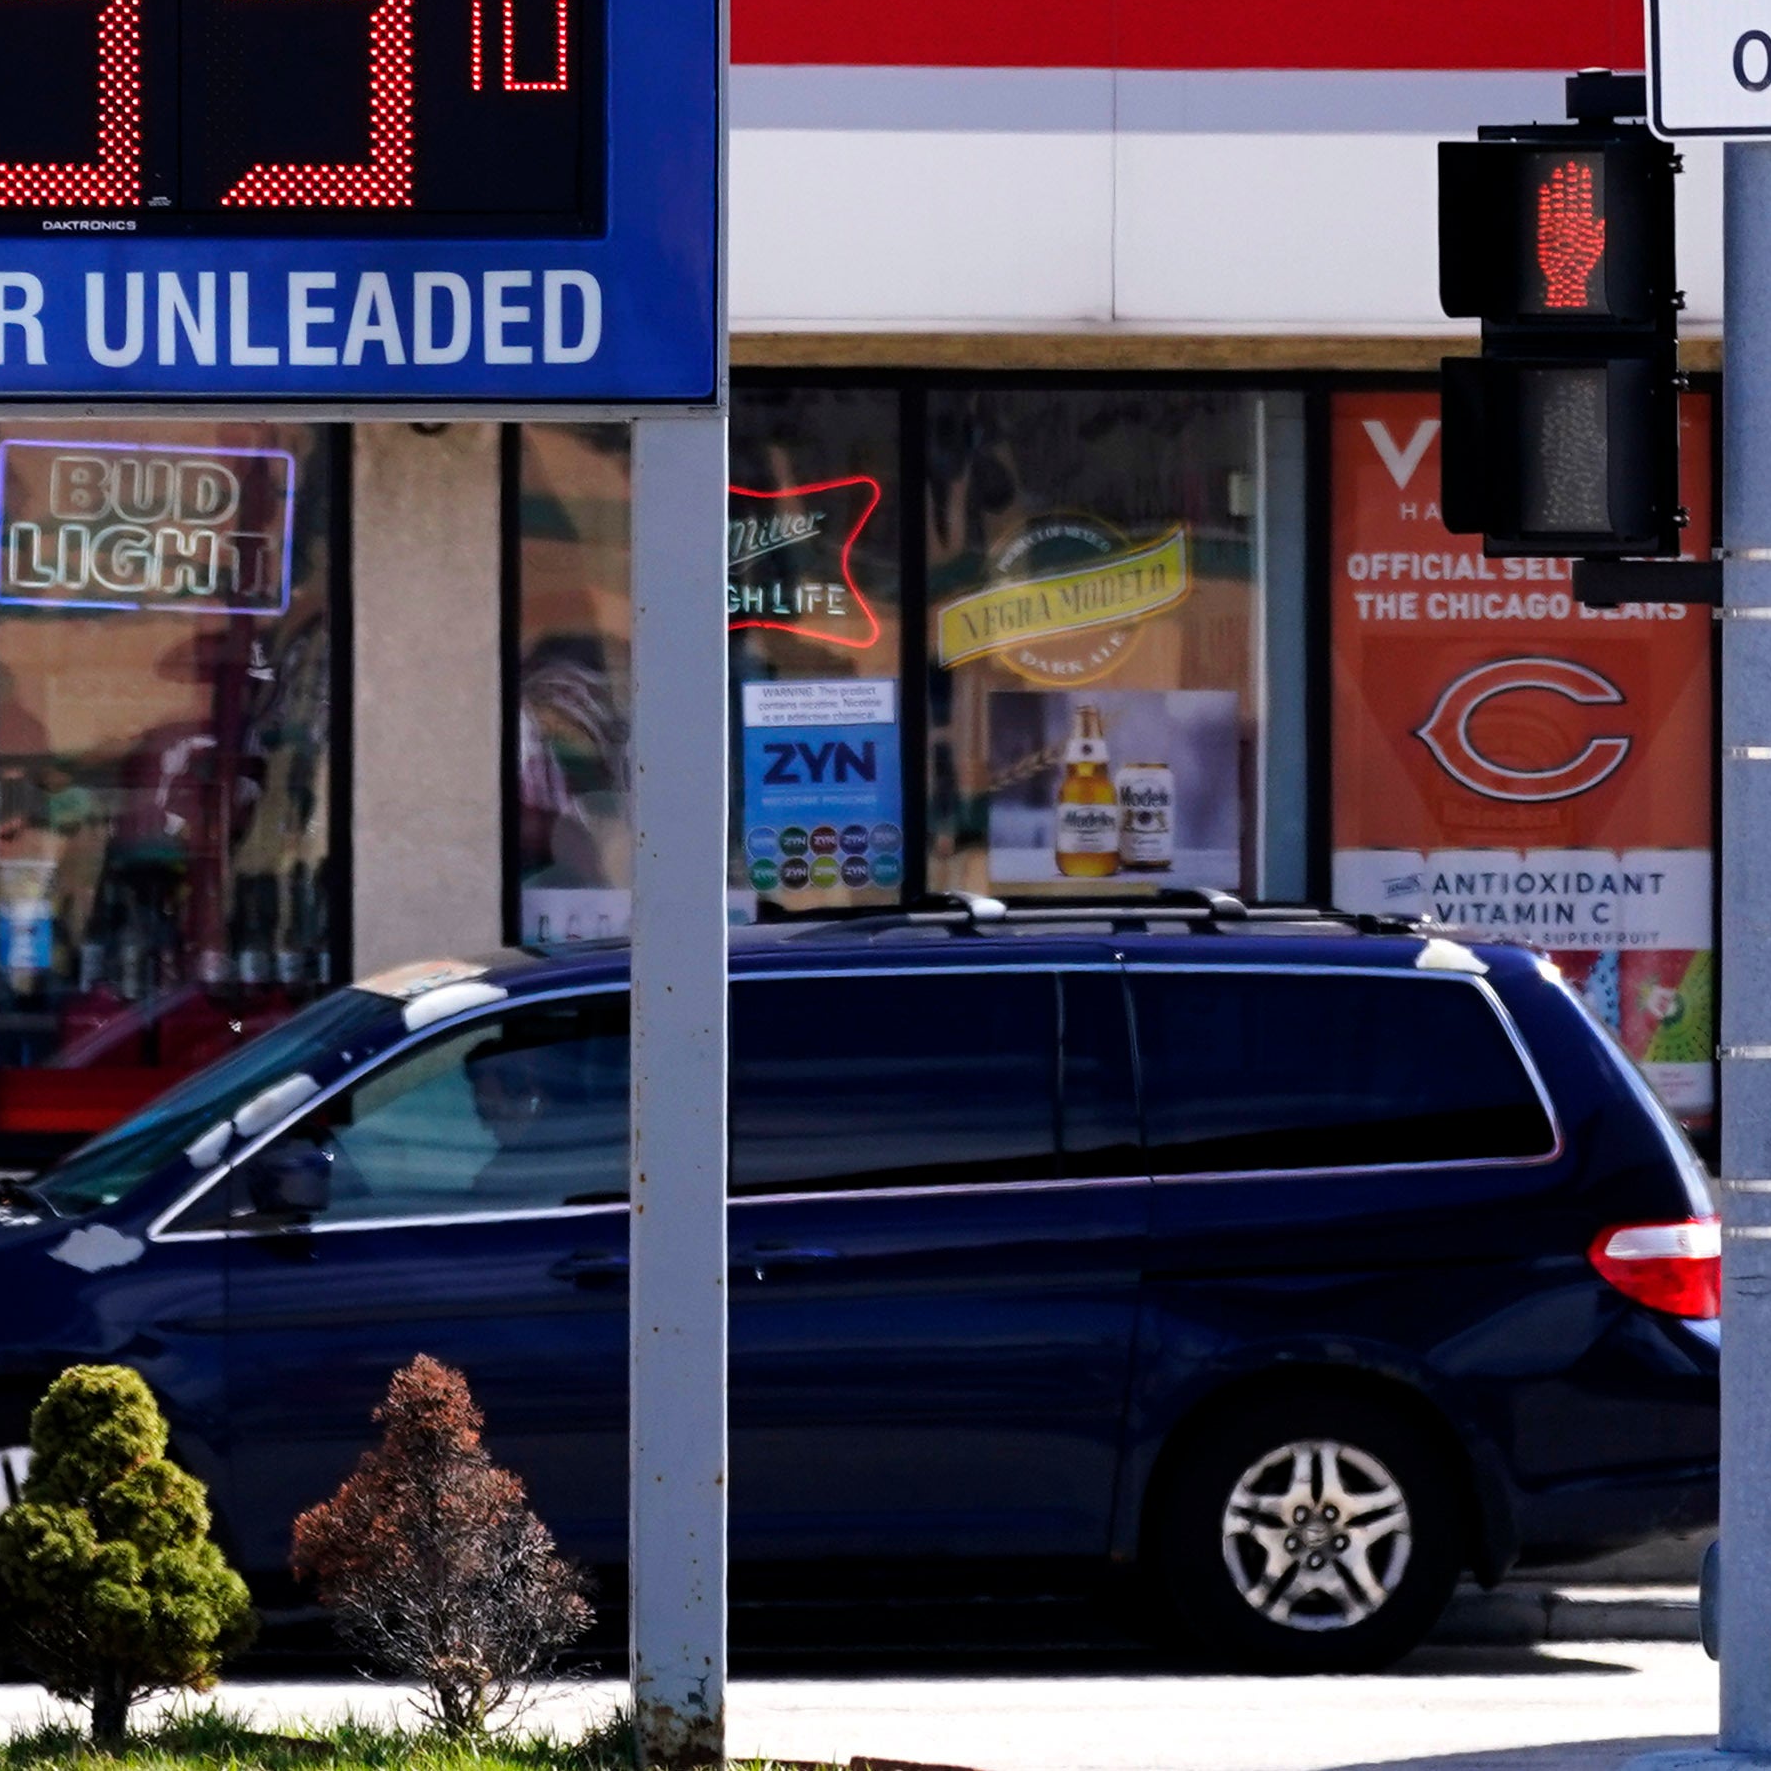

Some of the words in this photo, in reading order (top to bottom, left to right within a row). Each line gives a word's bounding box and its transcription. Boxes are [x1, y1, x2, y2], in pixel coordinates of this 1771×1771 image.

[42, 220, 137, 231] DAKTRONICS
[85, 268, 604, 367] UNLEADED
[49, 455, 241, 526] BUD
[1400, 503, 1442, 520] HA
[728, 510, 827, 558] Miller
[9, 521, 278, 599] LIGHT
[1347, 552, 1497, 581] OFFICIAL
[728, 584, 763, 614] GH
[773, 583, 846, 615] LIFE
[959, 592, 1051, 641] NEGRA
[1057, 563, 1167, 614] MODELO
[1354, 592, 1419, 621] THE
[1427, 592, 1571, 621] CHICAGO
[762, 740, 877, 785] ZYN
[1432, 872, 1666, 895] ANTIOXIDANT
[1435, 902, 1575, 924] VITAMIN
[1591, 902, 1610, 924] C
[1542, 931, 1661, 945] SUPERFRUIT
